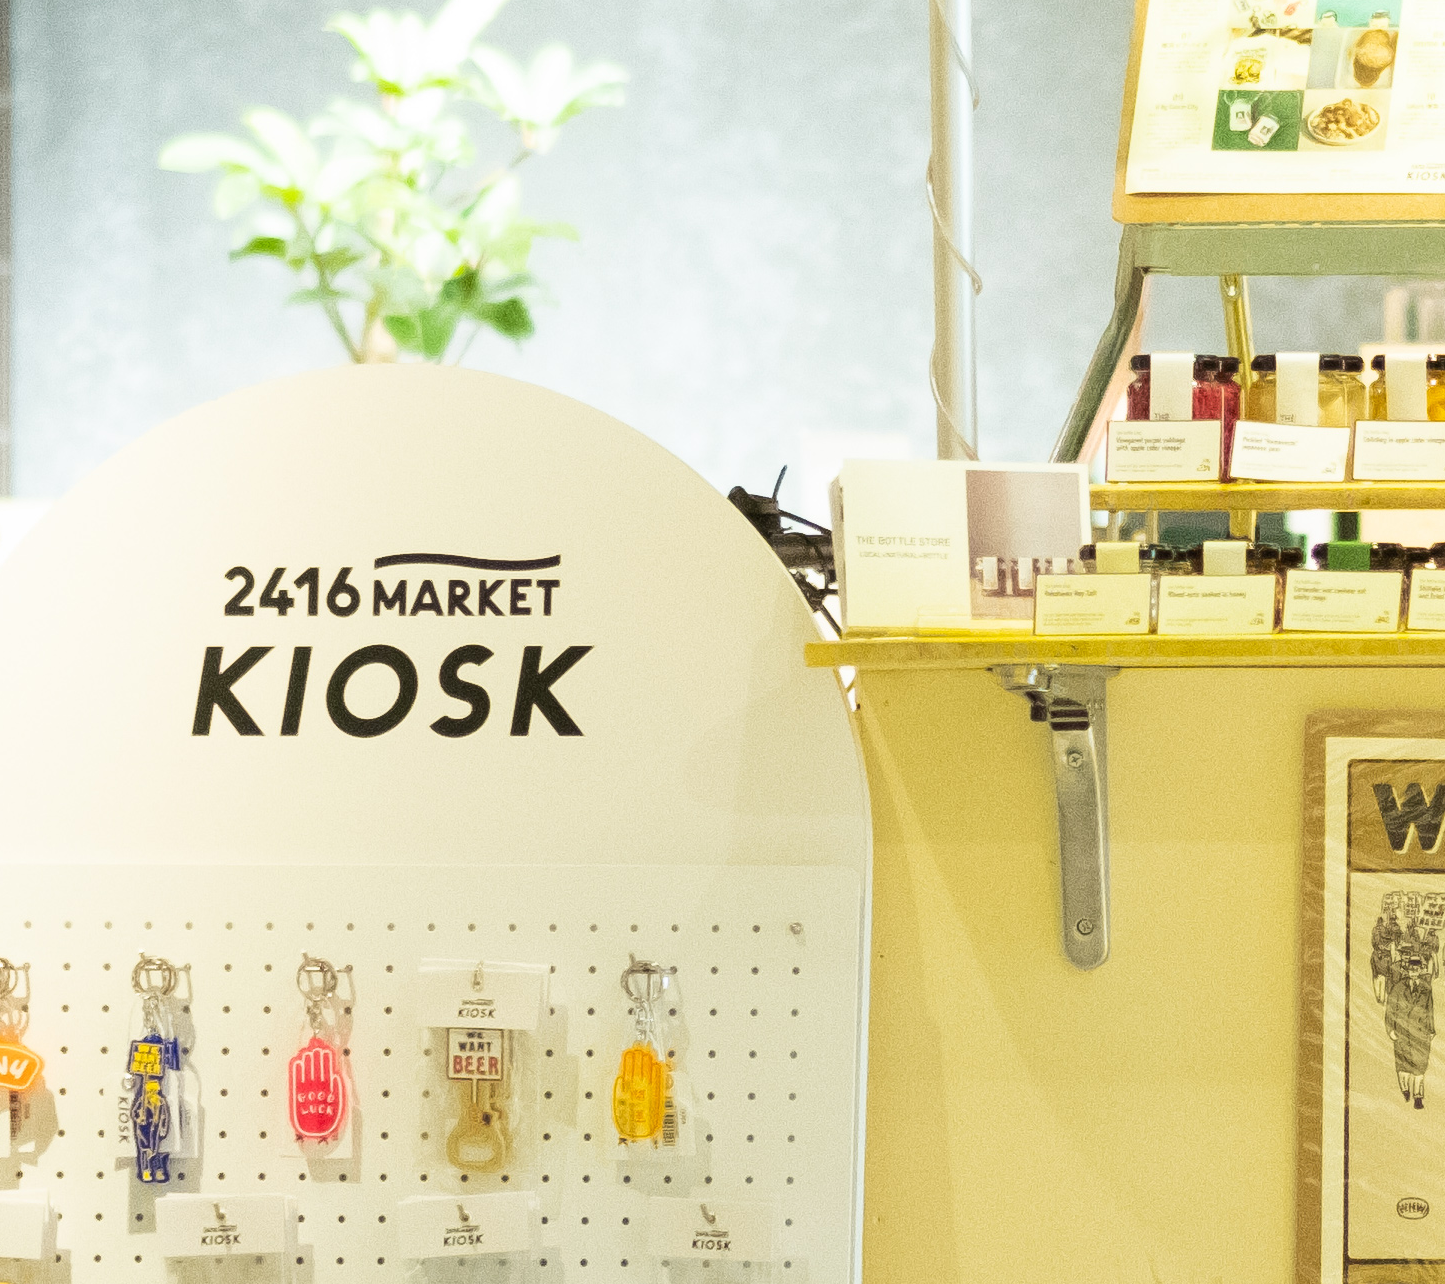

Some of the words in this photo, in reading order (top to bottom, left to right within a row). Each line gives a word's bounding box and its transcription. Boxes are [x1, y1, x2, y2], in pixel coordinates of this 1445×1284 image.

[857, 535, 875, 546] THE
[878, 535, 916, 547] BOTTLE
[919, 536, 951, 547] STORE
[223, 565, 361, 618] 2416
[372, 578, 561, 617] MARKET
[191, 643, 595, 738] KIOSK
[457, 1007, 496, 1019] KIOSK
[458, 1042, 493, 1052] WANT
[453, 1055, 499, 1075] BEER
[117, 1096, 130, 1144] KIOSK
[201, 1233, 242, 1247] KIOSK
[443, 1233, 484, 1247] KIOSK
[691, 1239, 732, 1252] KIOSK
